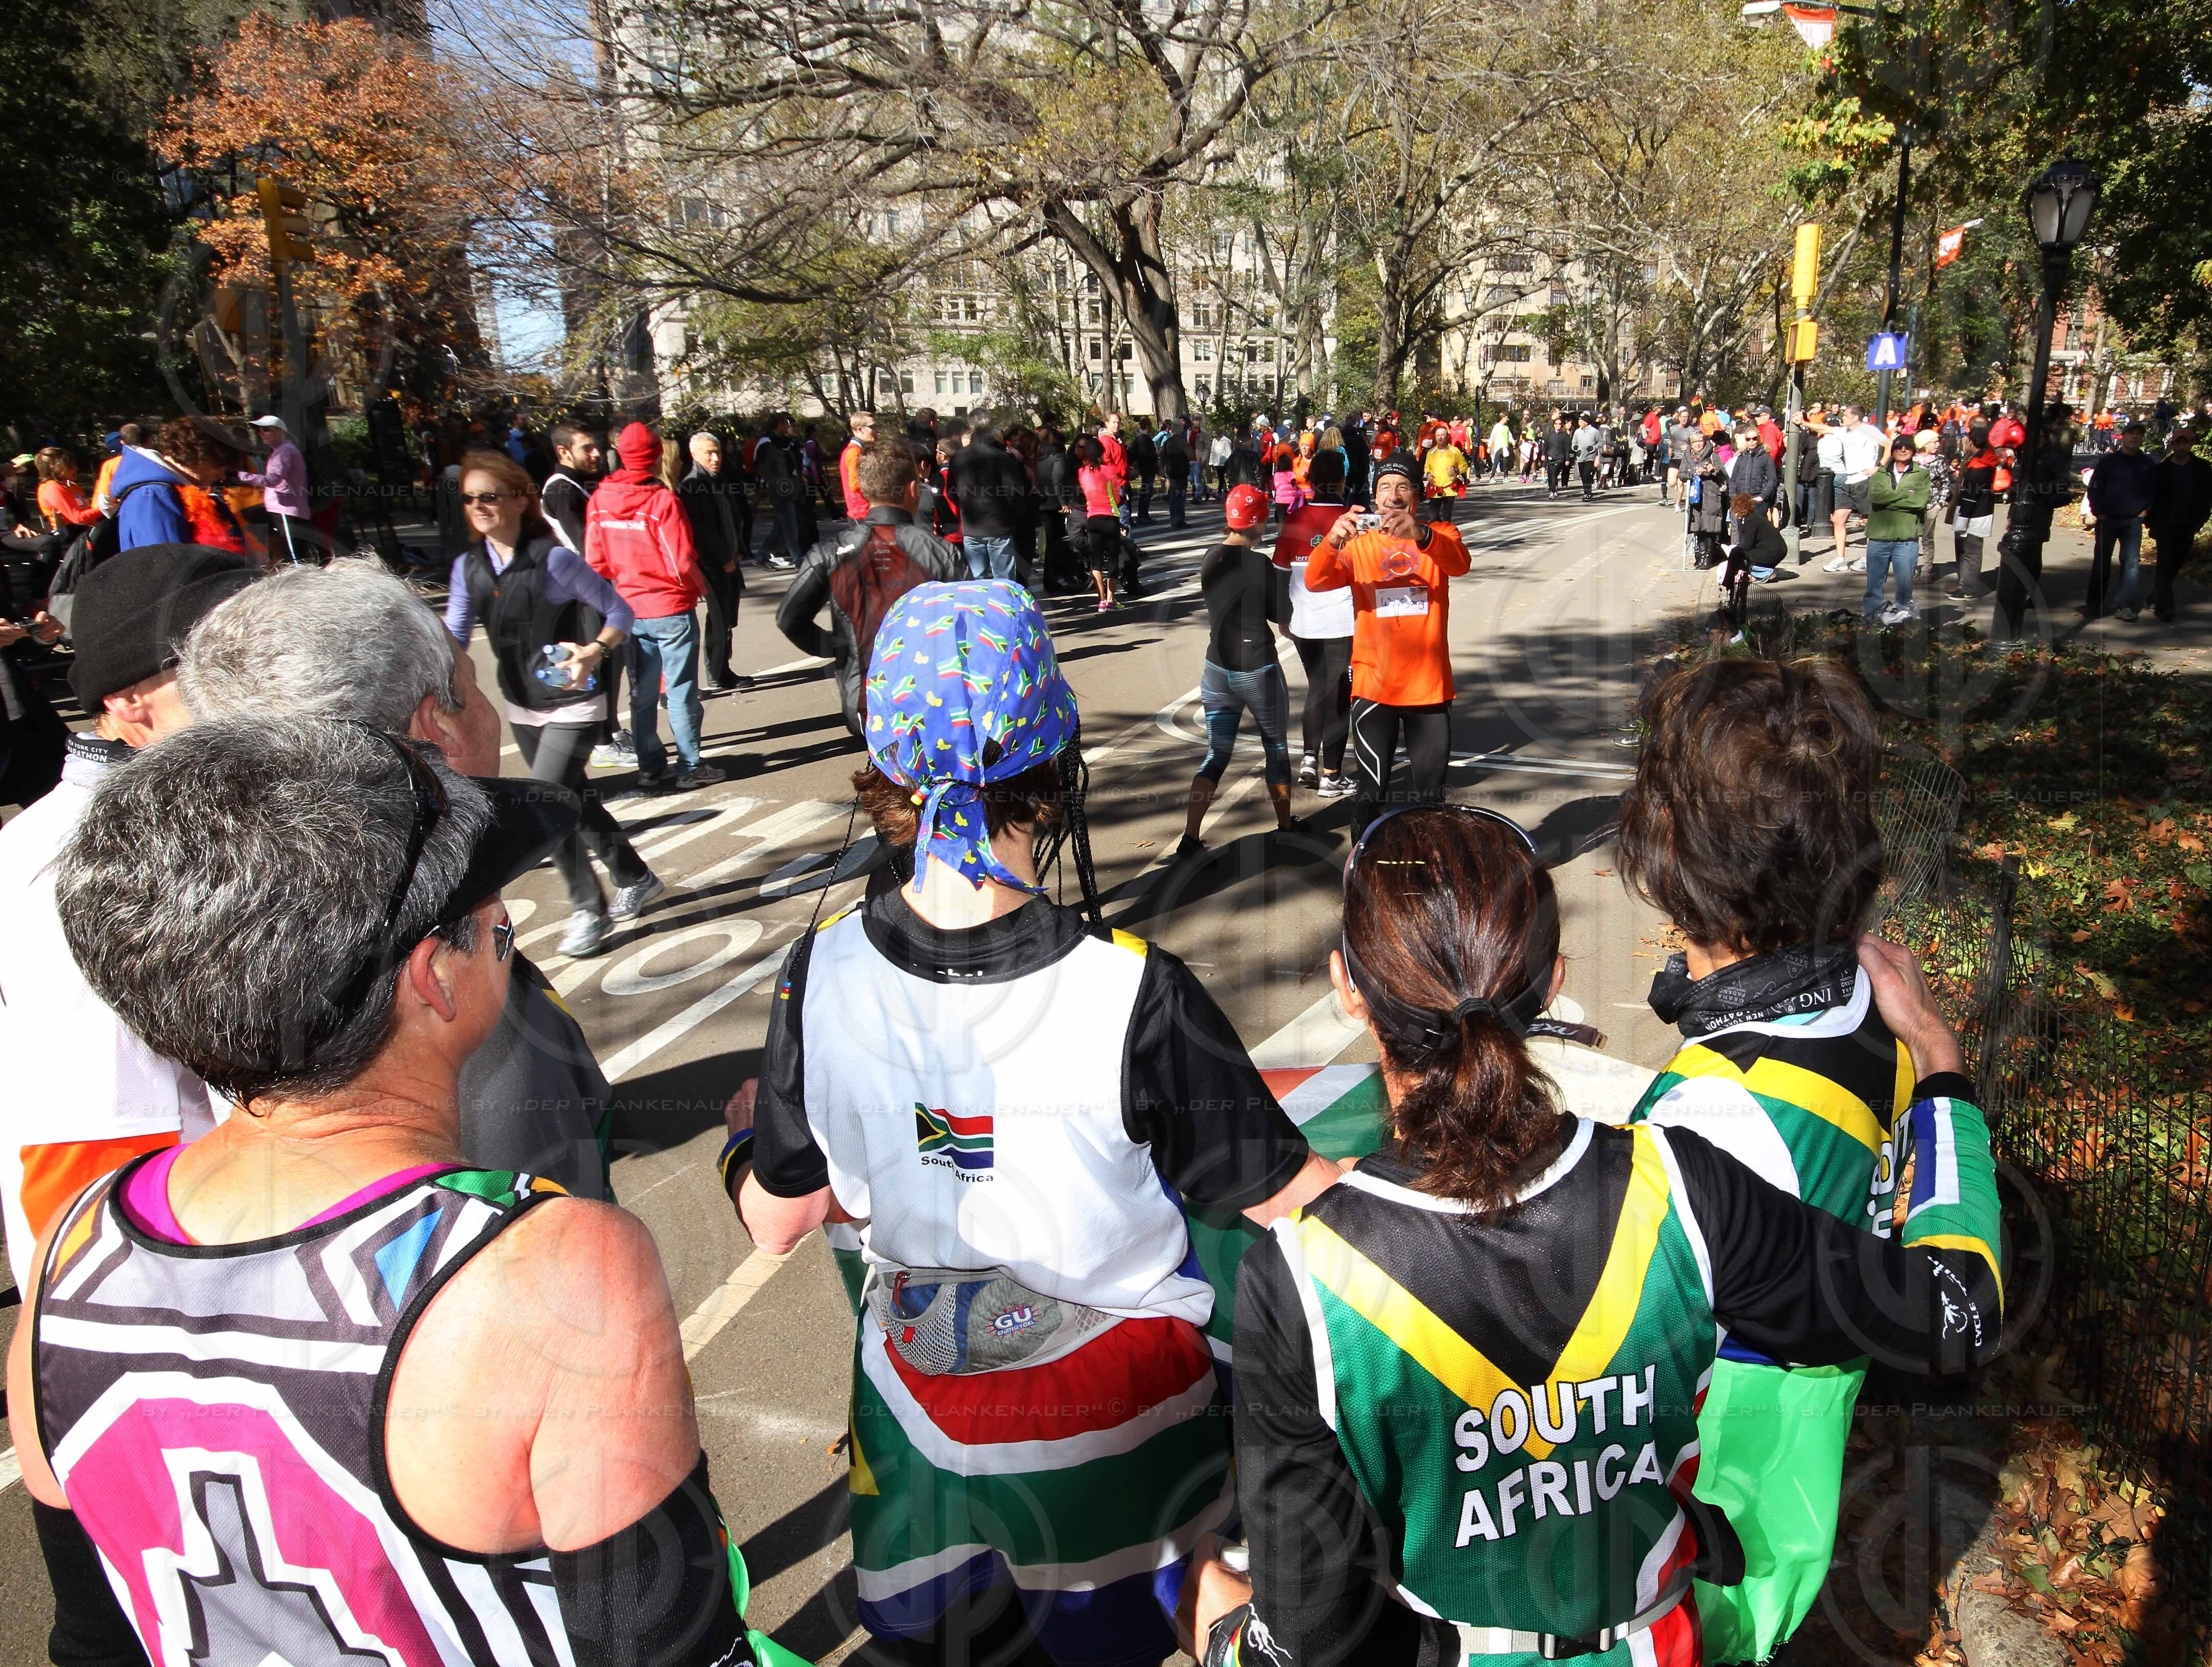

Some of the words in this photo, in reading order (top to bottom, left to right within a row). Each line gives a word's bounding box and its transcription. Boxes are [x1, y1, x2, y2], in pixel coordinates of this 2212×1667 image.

[1875, 338, 1896, 365] A
[74, 743, 89, 751] YORK
[1718, 988, 1746, 998] PADANO
[1718, 993, 1744, 1003] GRANA
[1799, 988, 1832, 1008] ING
[1745, 1011, 1764, 1021] NEW
[955, 1170, 994, 1183] Africa
[995, 1308, 1032, 1329] GU
[1454, 1364, 1656, 1473] SOUTH
[1454, 1440, 1664, 1549] AFRICA
